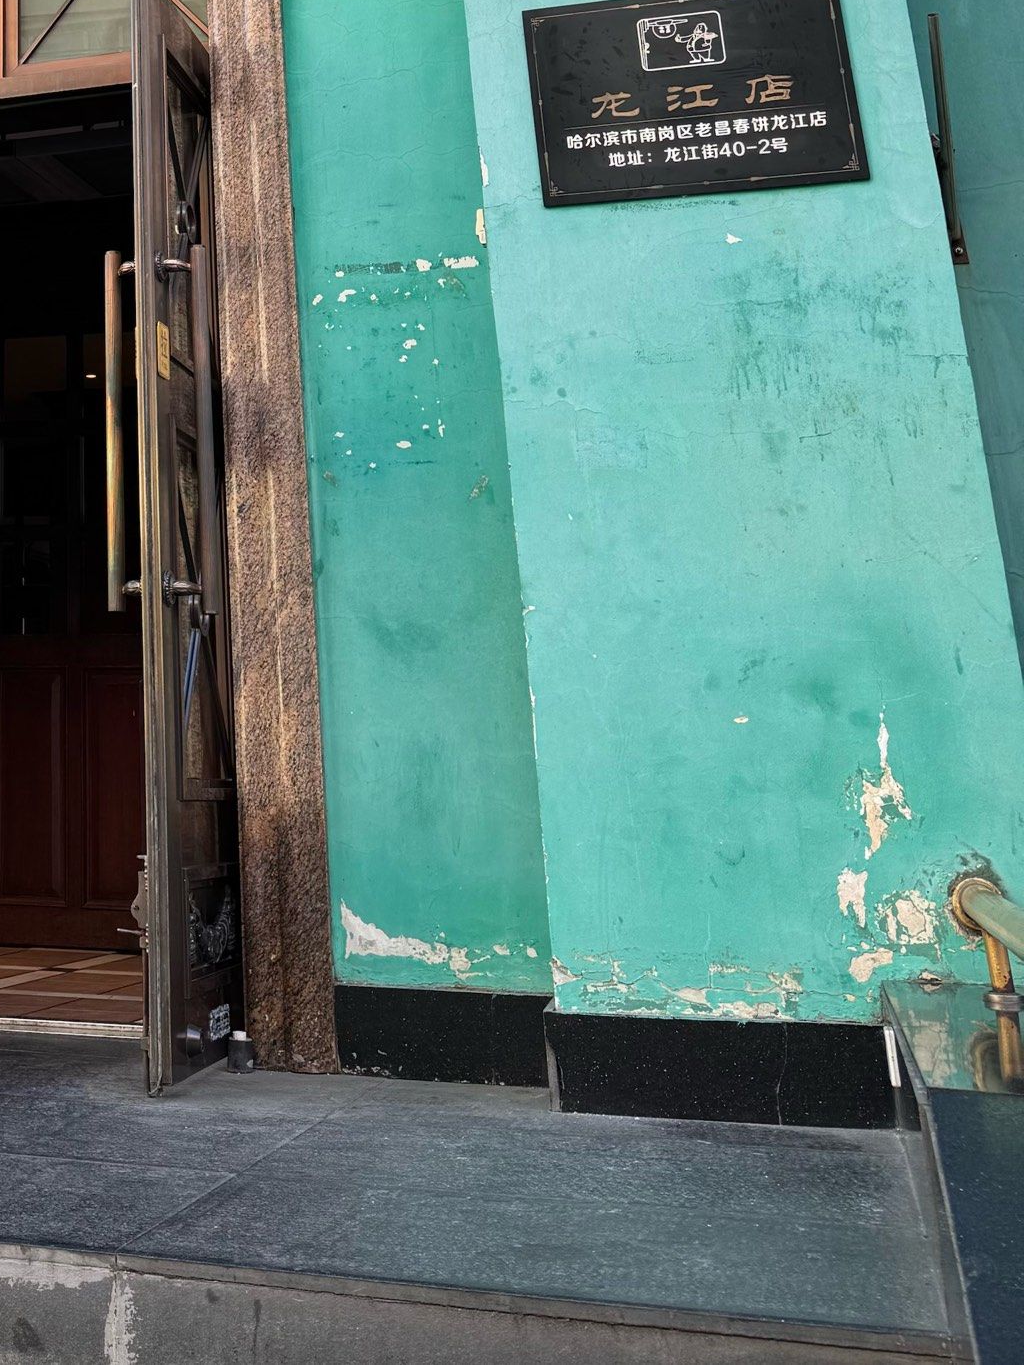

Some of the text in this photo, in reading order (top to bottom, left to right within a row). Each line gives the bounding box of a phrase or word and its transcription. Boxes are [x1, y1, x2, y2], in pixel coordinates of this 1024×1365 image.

[591, 74, 795, 119] 龙江店
[566, 111, 827, 150] 哈尔滨市南岗区老昌春饼龙江店
